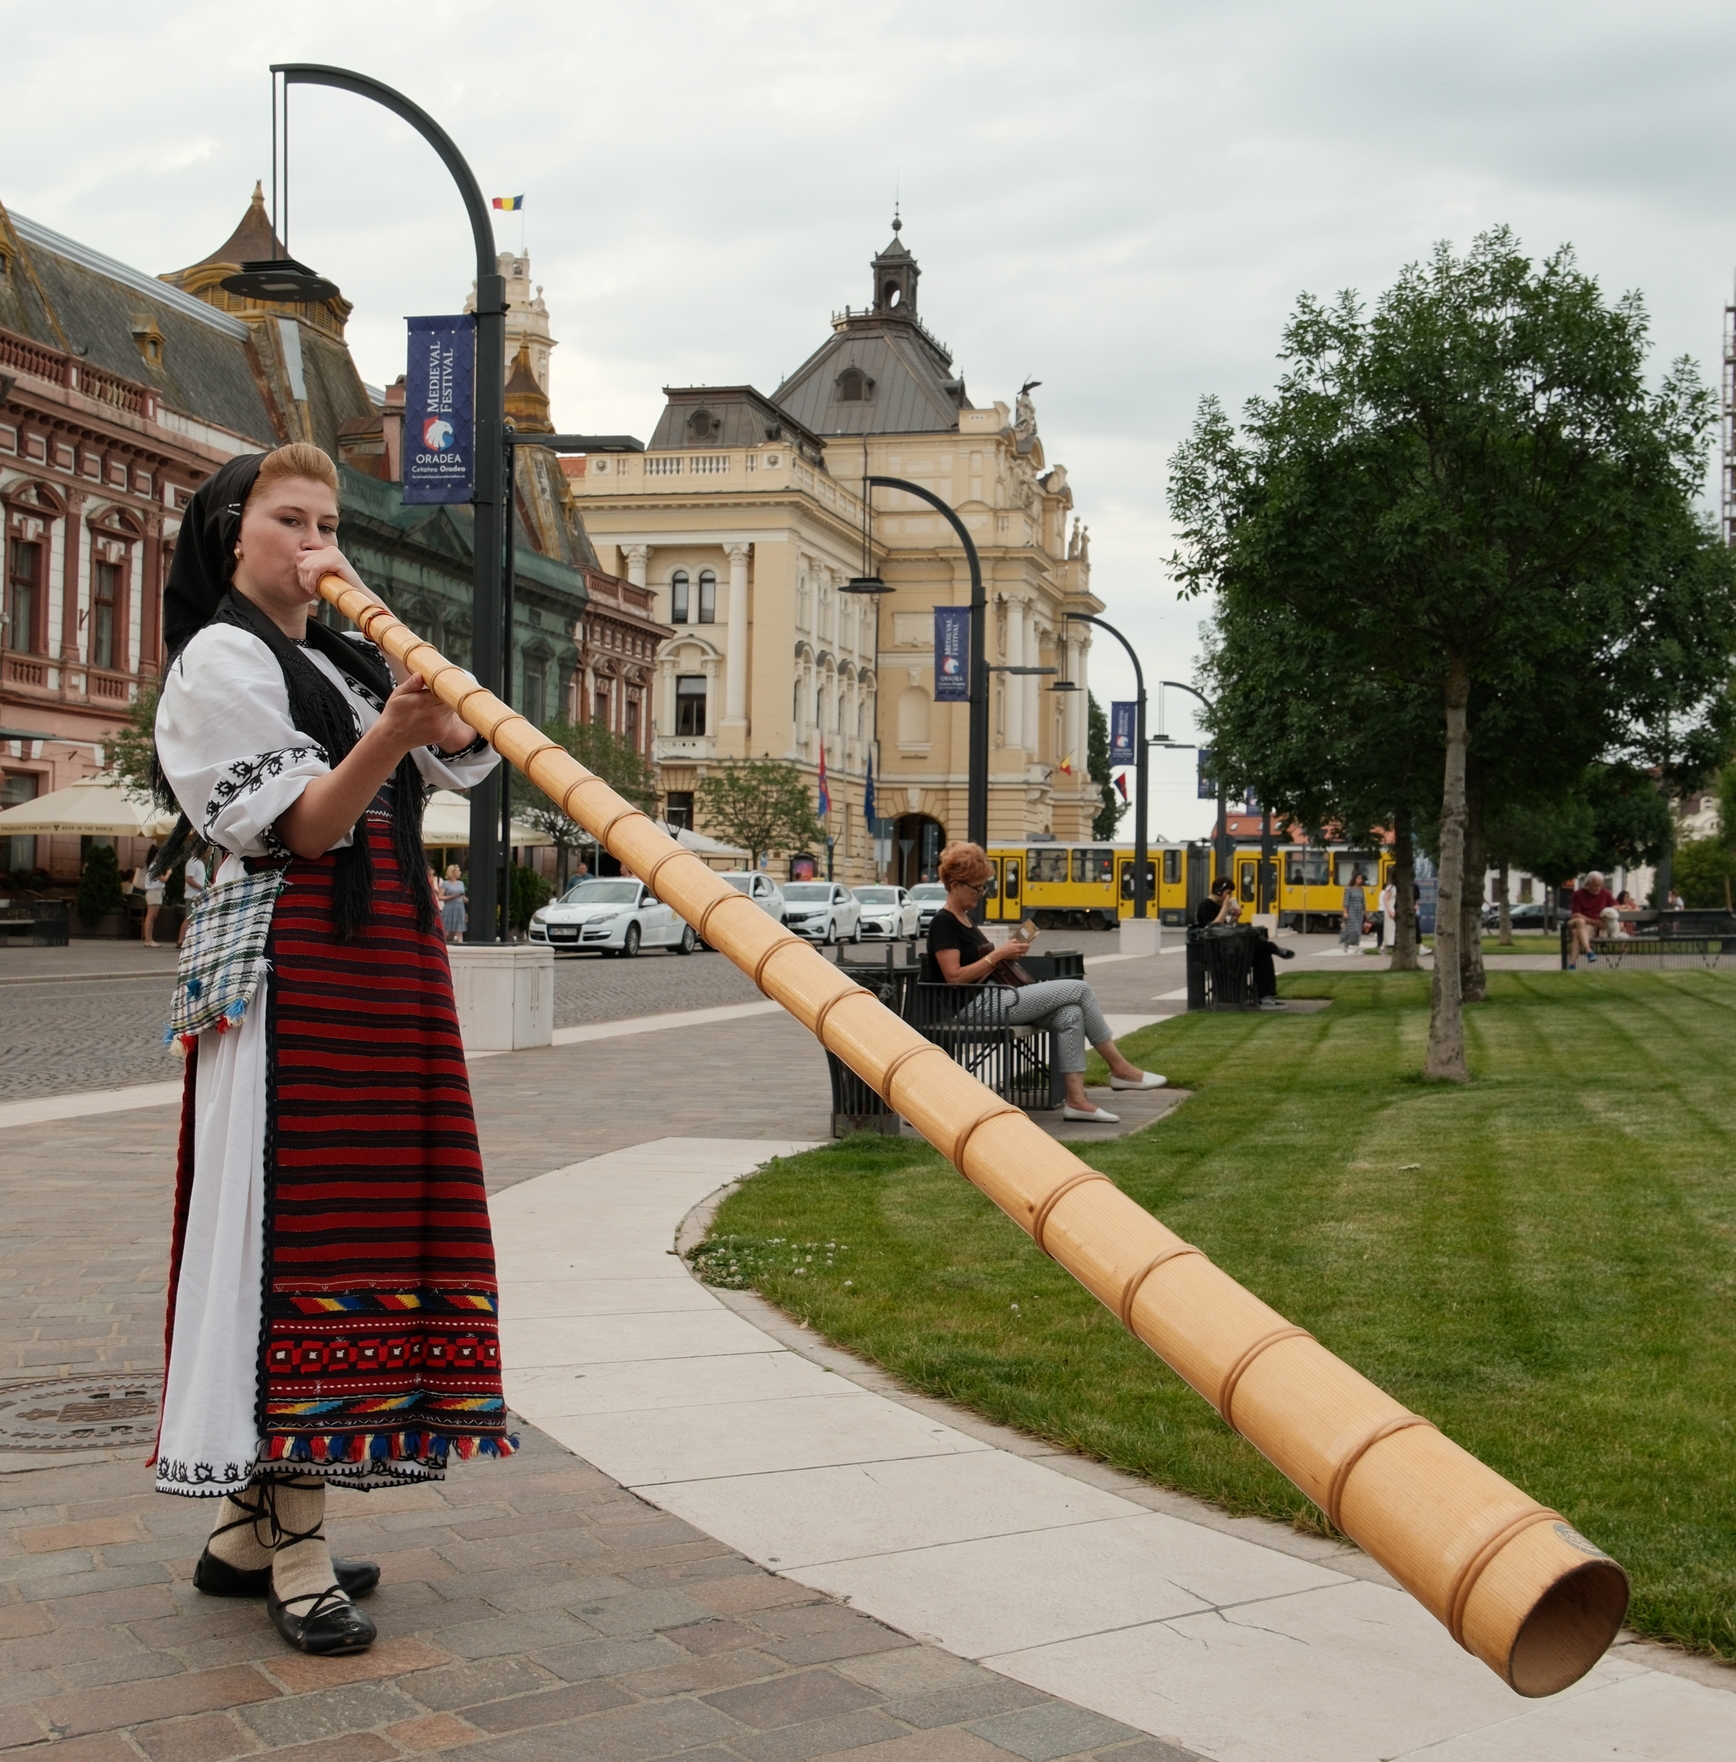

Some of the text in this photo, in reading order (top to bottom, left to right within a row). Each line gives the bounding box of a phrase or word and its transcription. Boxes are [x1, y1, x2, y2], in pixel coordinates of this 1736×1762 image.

[427, 341, 441, 413] MEDIEVAL
[441, 348, 454, 413] FESTIVAL
[411, 464, 466, 473] Cetatea Oradea
[416, 453, 462, 464] ORADEA
